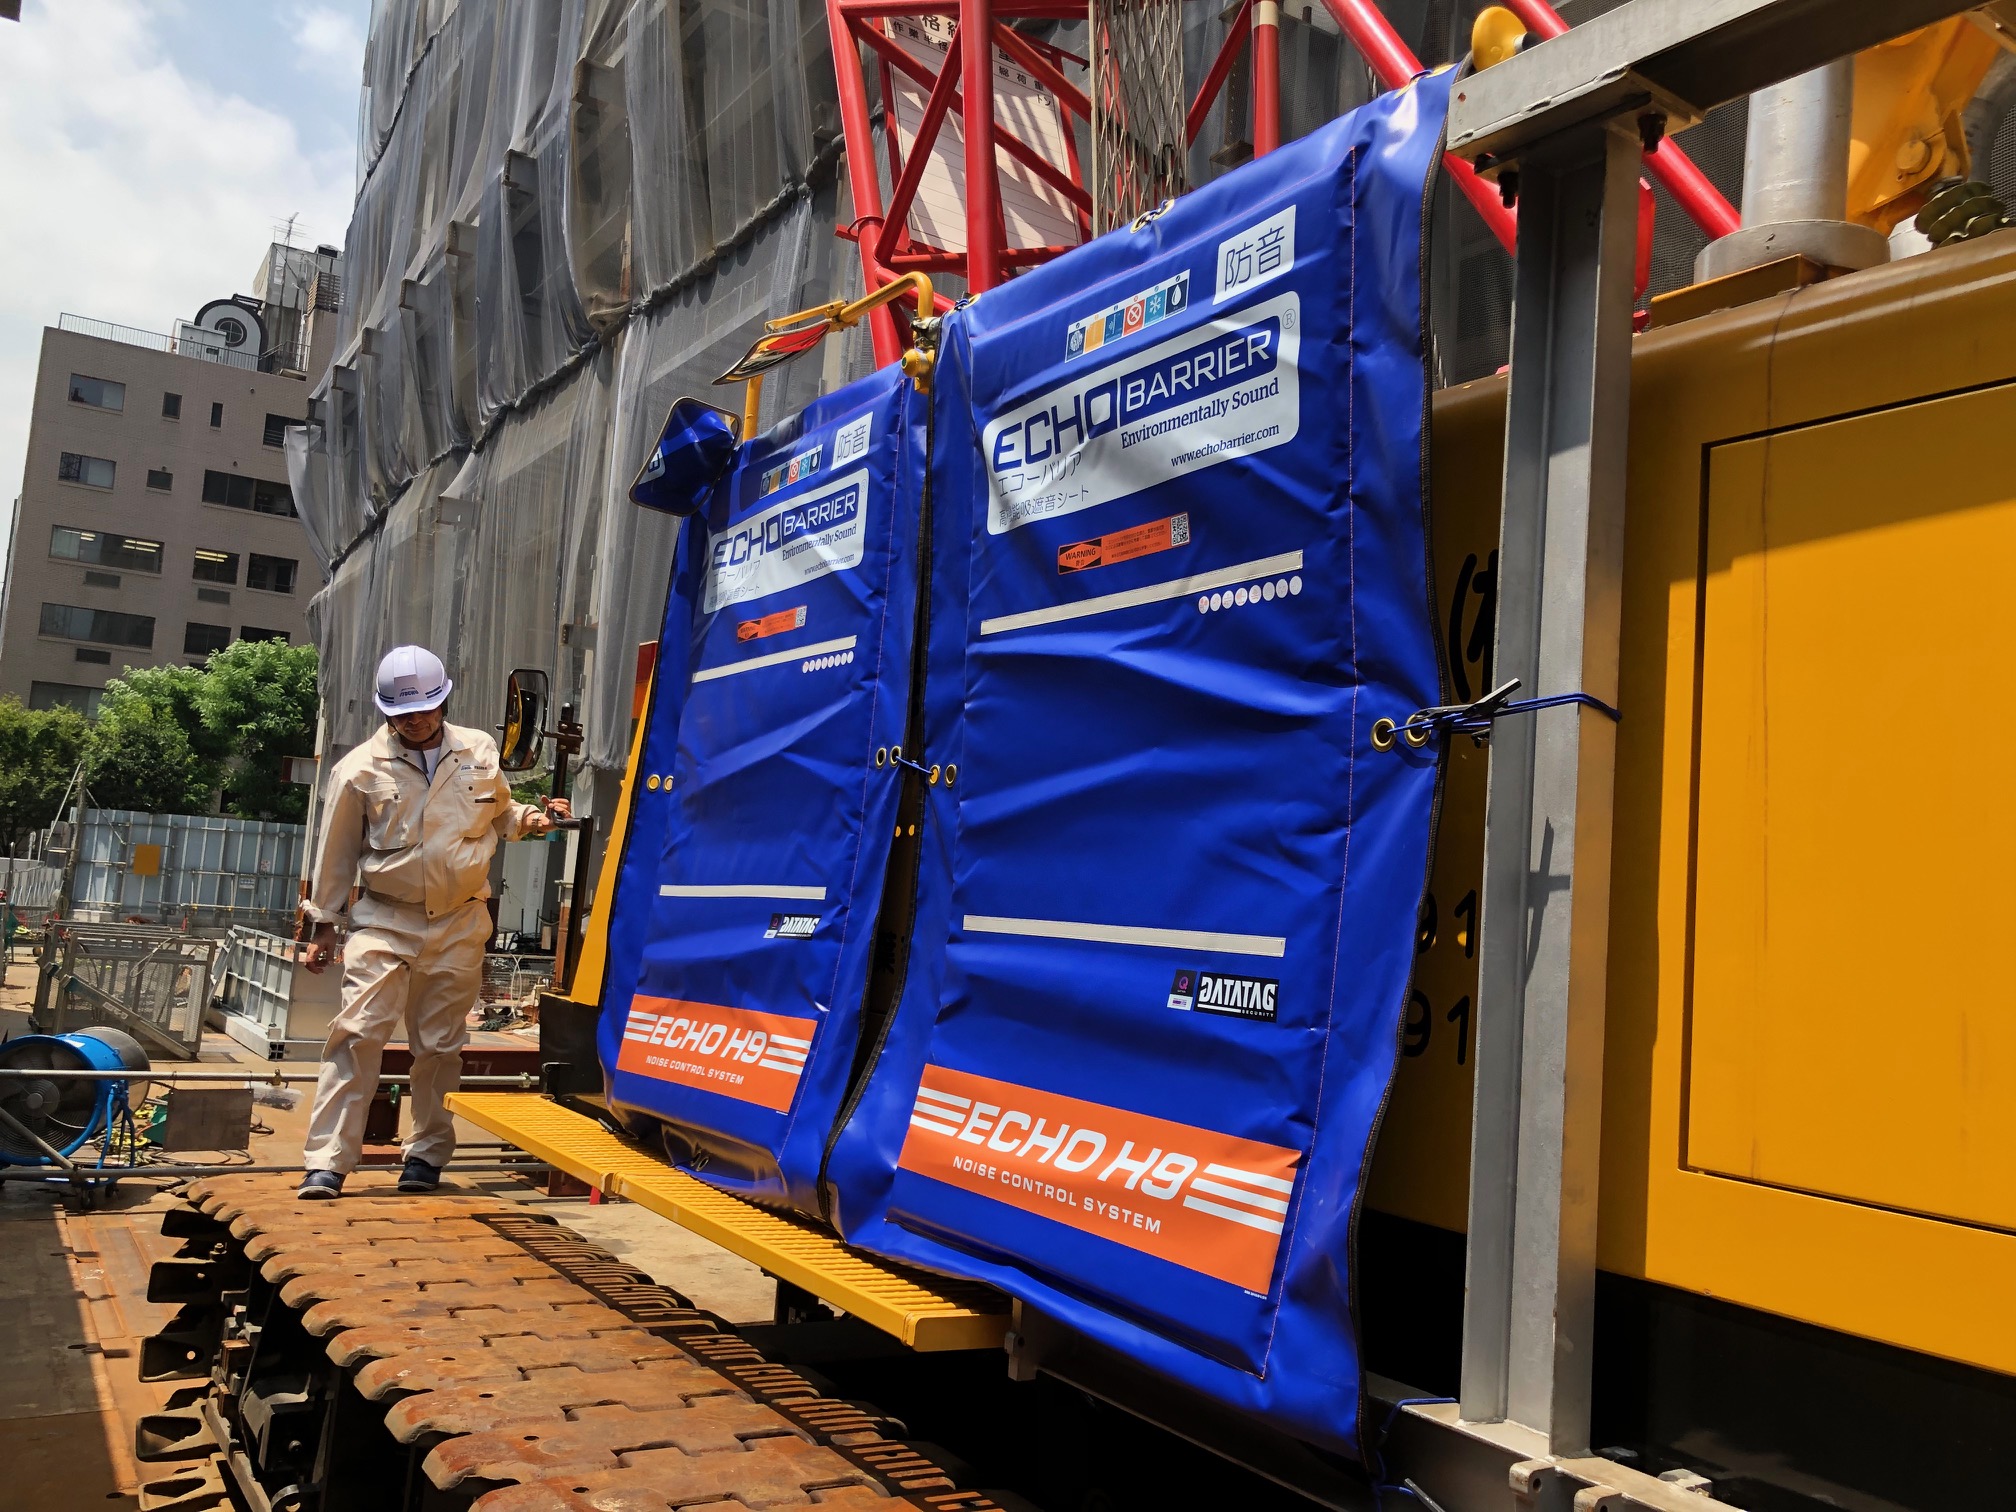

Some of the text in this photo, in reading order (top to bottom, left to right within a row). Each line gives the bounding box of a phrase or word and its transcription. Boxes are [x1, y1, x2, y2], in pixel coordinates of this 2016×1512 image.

[1224, 225, 1285, 292] 防音
[993, 329, 1272, 473] ECHO BARRIER
[1121, 377, 1280, 449] Environmentally Sound
[836, 424, 867, 462] 防音
[1171, 424, 1280, 467] www.echobarrier.com
[998, 452, 1082, 497] エコーバリア
[712, 491, 856, 571] ECHO BARRIER
[834, 523, 857, 541] Sound
[1065, 548, 1096, 560] WARNING
[779, 916, 821, 934] DATATAG
[1199, 976, 1277, 1011] DATATAG
[1242, 1009, 1274, 1018] SECURITY
[649, 1013, 768, 1064] ECHO H9
[646, 1055, 745, 1085] NOISE CONTROL SYSTEM
[957, 1101, 1200, 1200] ECHO H9
[952, 1155, 1162, 1235] NOISE CONTROL SYSTEM
